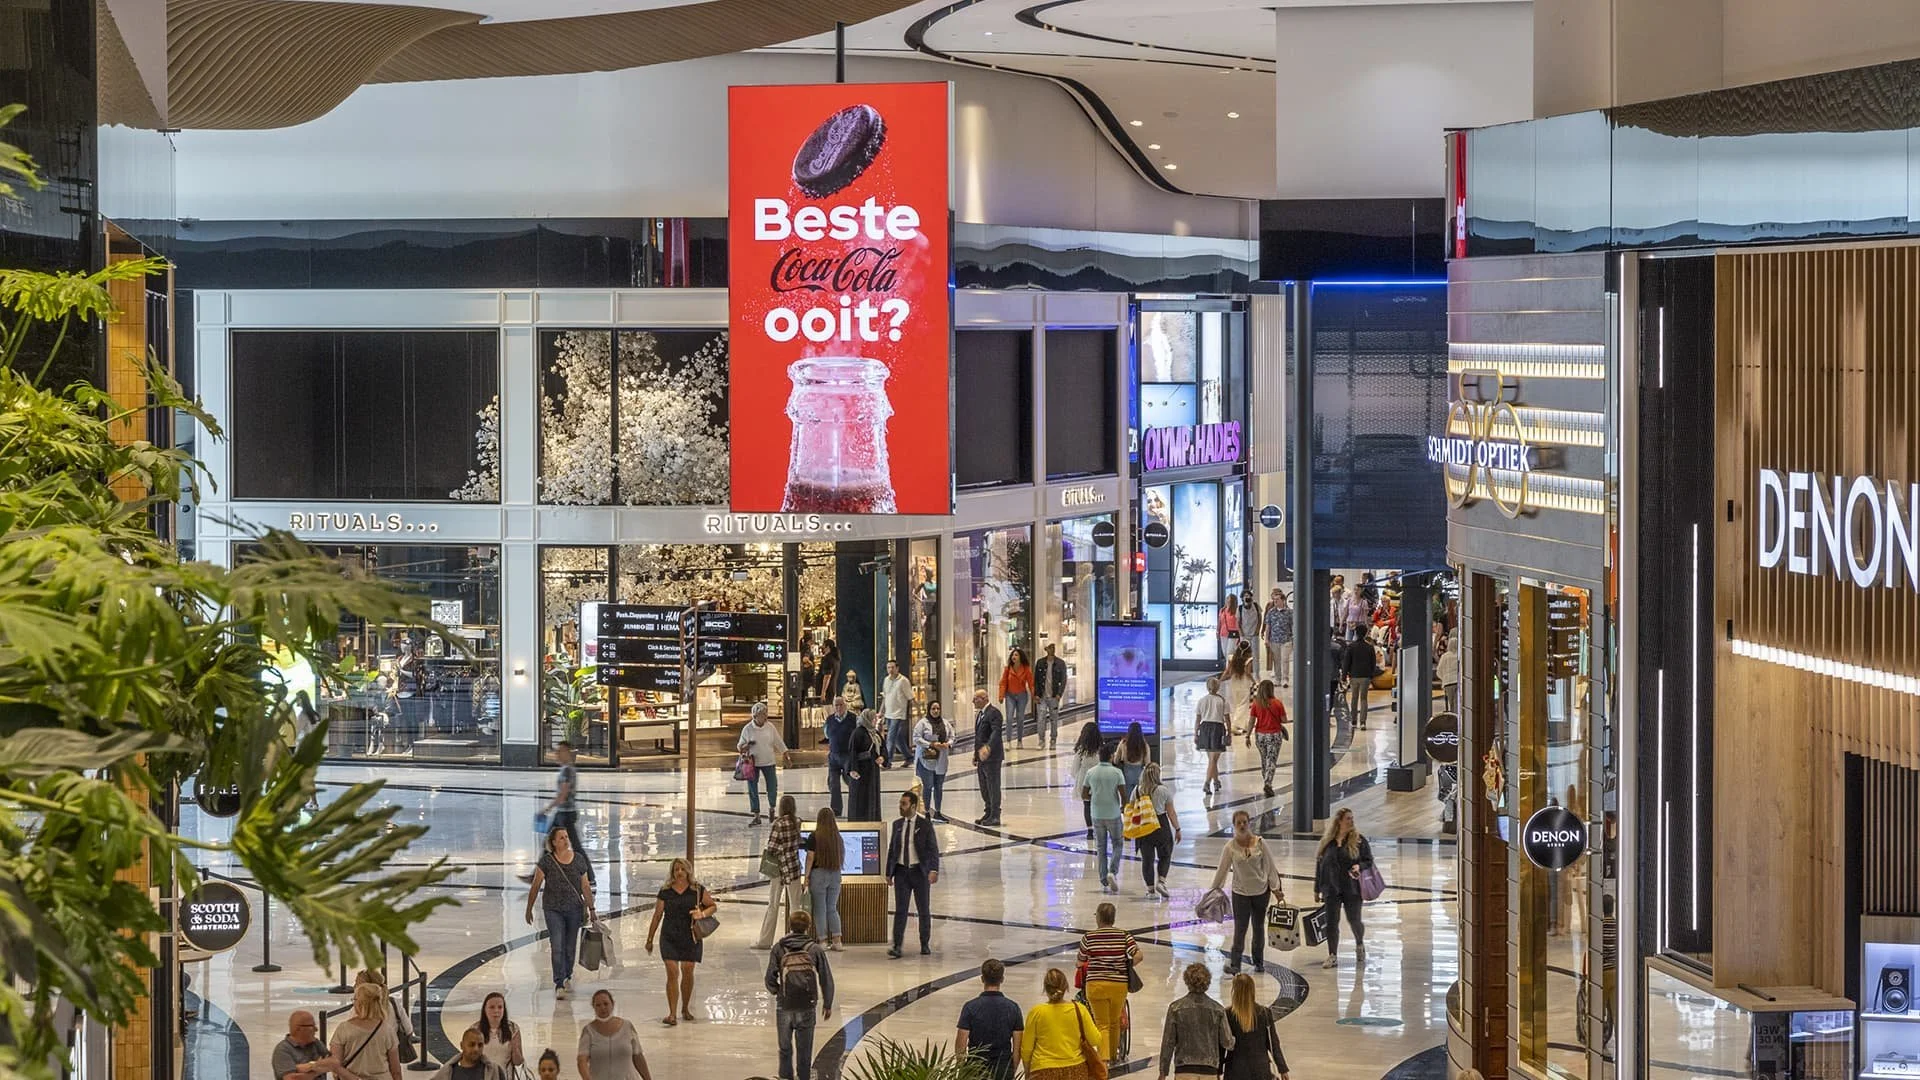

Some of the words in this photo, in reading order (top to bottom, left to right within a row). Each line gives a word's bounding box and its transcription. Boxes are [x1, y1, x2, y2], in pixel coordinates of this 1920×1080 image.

[754, 196, 920, 241] Beste
[770, 247, 905, 292] Coca-Cola
[764, 295, 910, 342] ooit?
[1428, 435, 1474, 465] SCHMIDT
[1477, 442, 1530, 472] OPTIEK
[289, 512, 438, 533] RITUALS...
[704, 512, 852, 533] RITUALS...
[1759, 468, 1920, 595] DENON
[1532, 830, 1580, 843] DENON
[190, 903, 240, 914] SCOTCH
[190, 914, 203, 925] &
[204, 914, 240, 924] SODA
